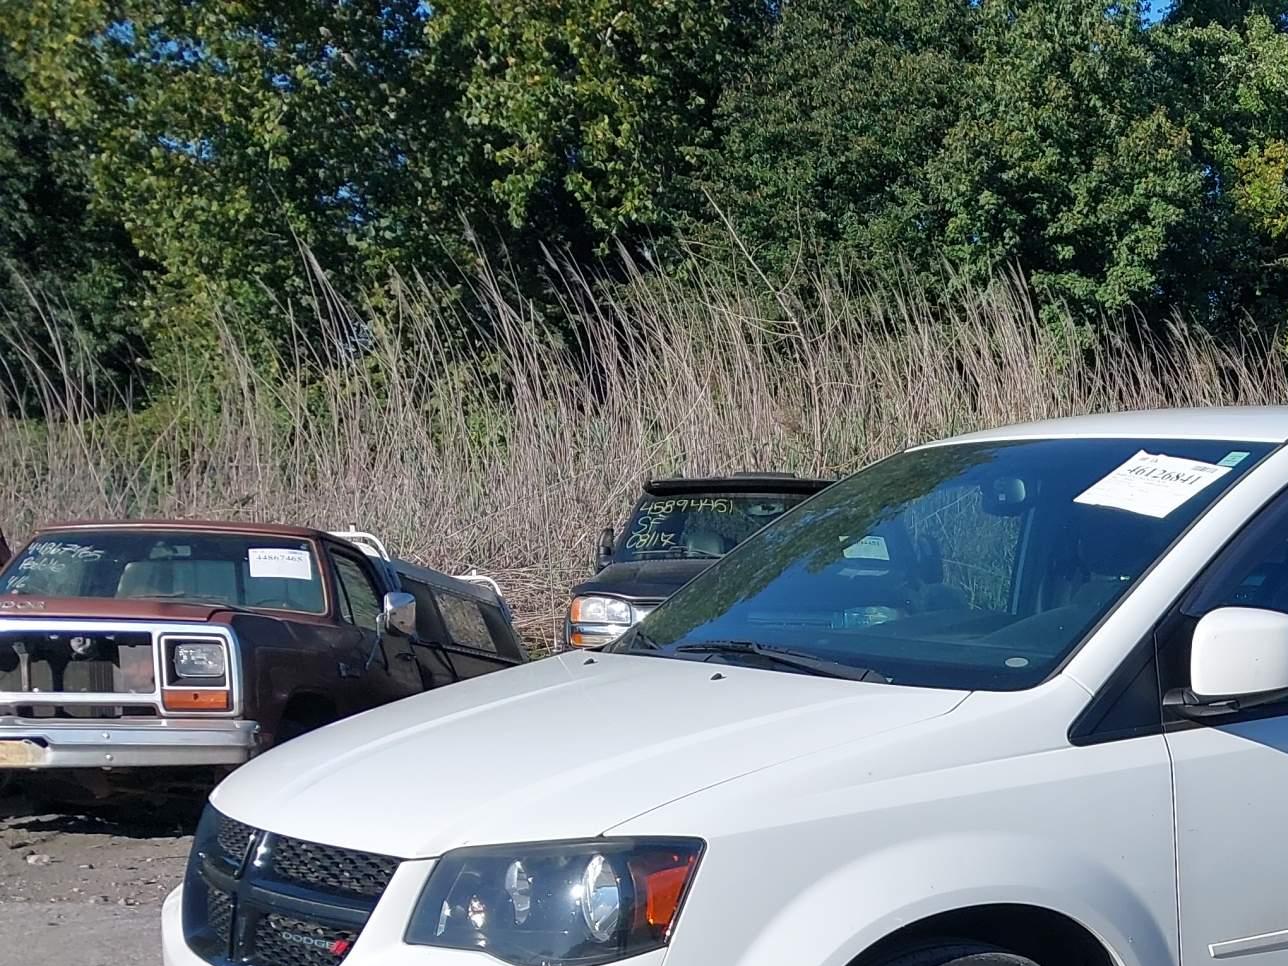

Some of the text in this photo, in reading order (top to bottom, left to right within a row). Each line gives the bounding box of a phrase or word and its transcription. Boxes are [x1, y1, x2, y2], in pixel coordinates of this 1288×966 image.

[1127, 465, 1203, 486] 46126841
[640, 498, 733, 516] 45894451
[282, 931, 337, 950] DODGE
